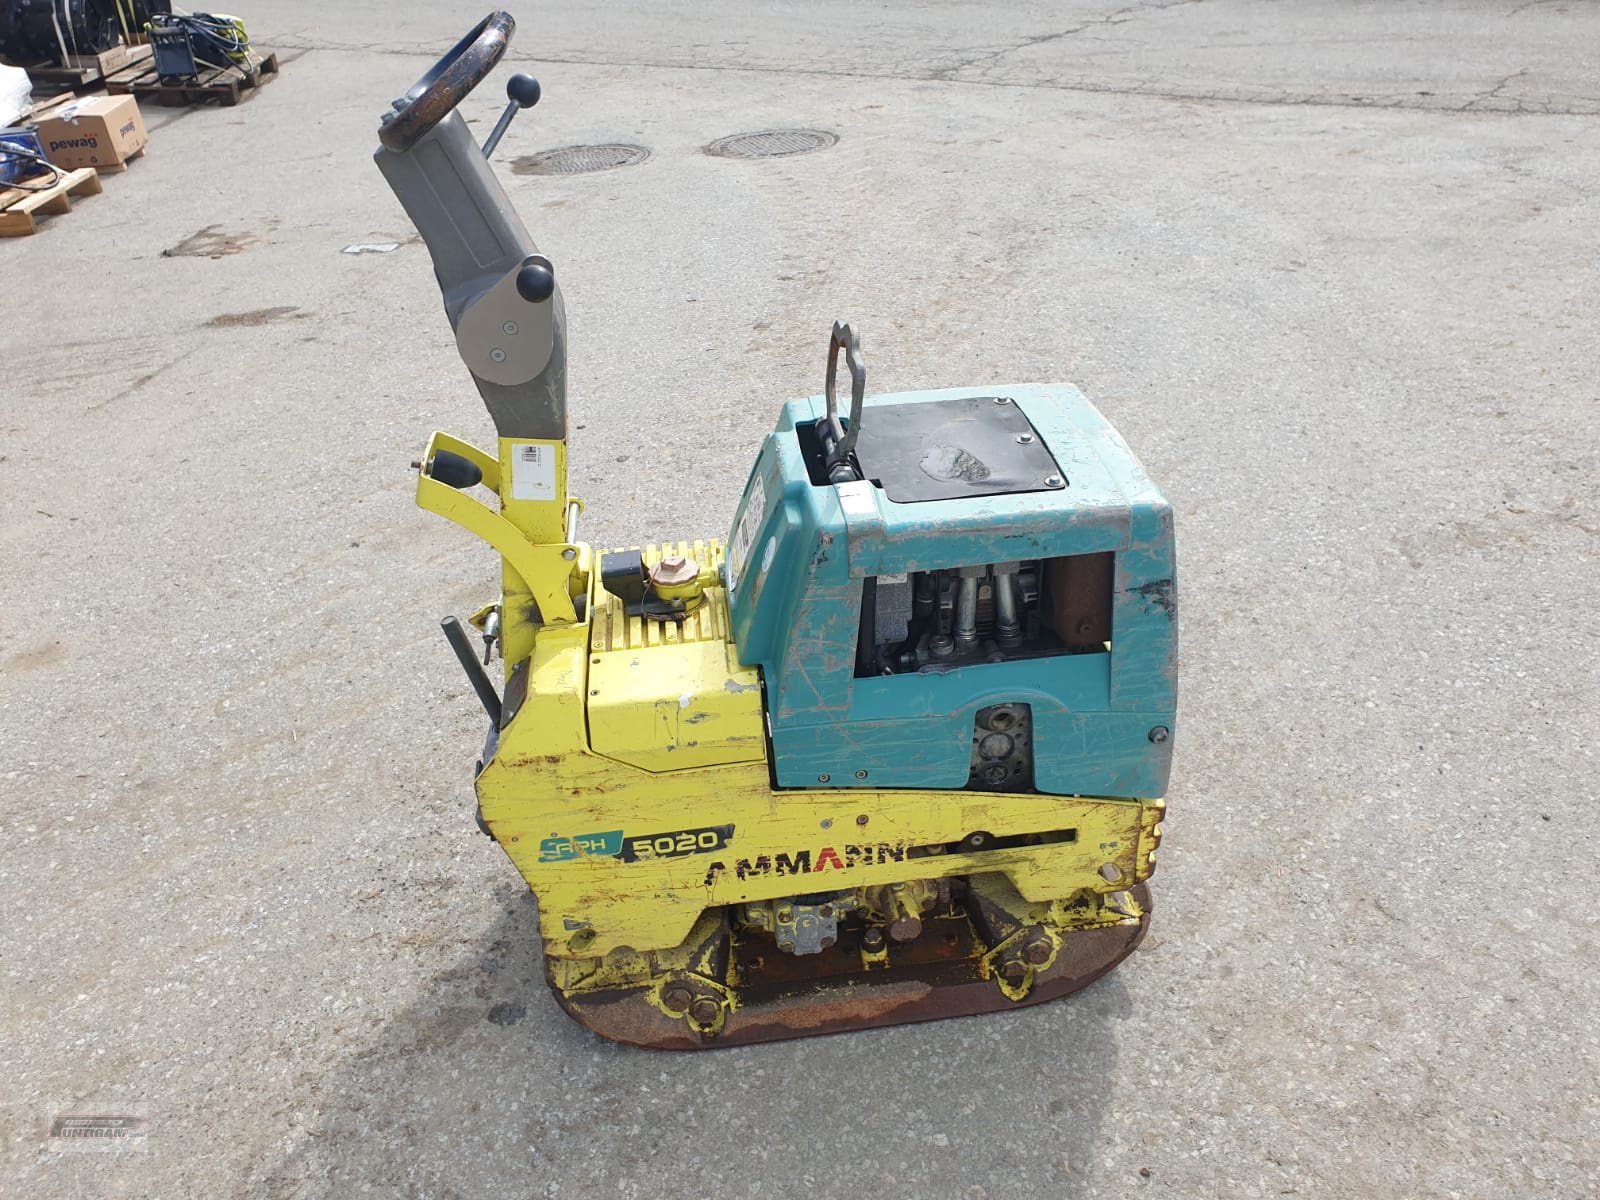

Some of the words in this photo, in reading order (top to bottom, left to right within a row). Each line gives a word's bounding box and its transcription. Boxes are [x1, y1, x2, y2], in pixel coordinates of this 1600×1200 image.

[50, 137, 98, 151] pewag
[632, 831, 719, 858] 5020
[703, 842, 904, 886] AMMANN
